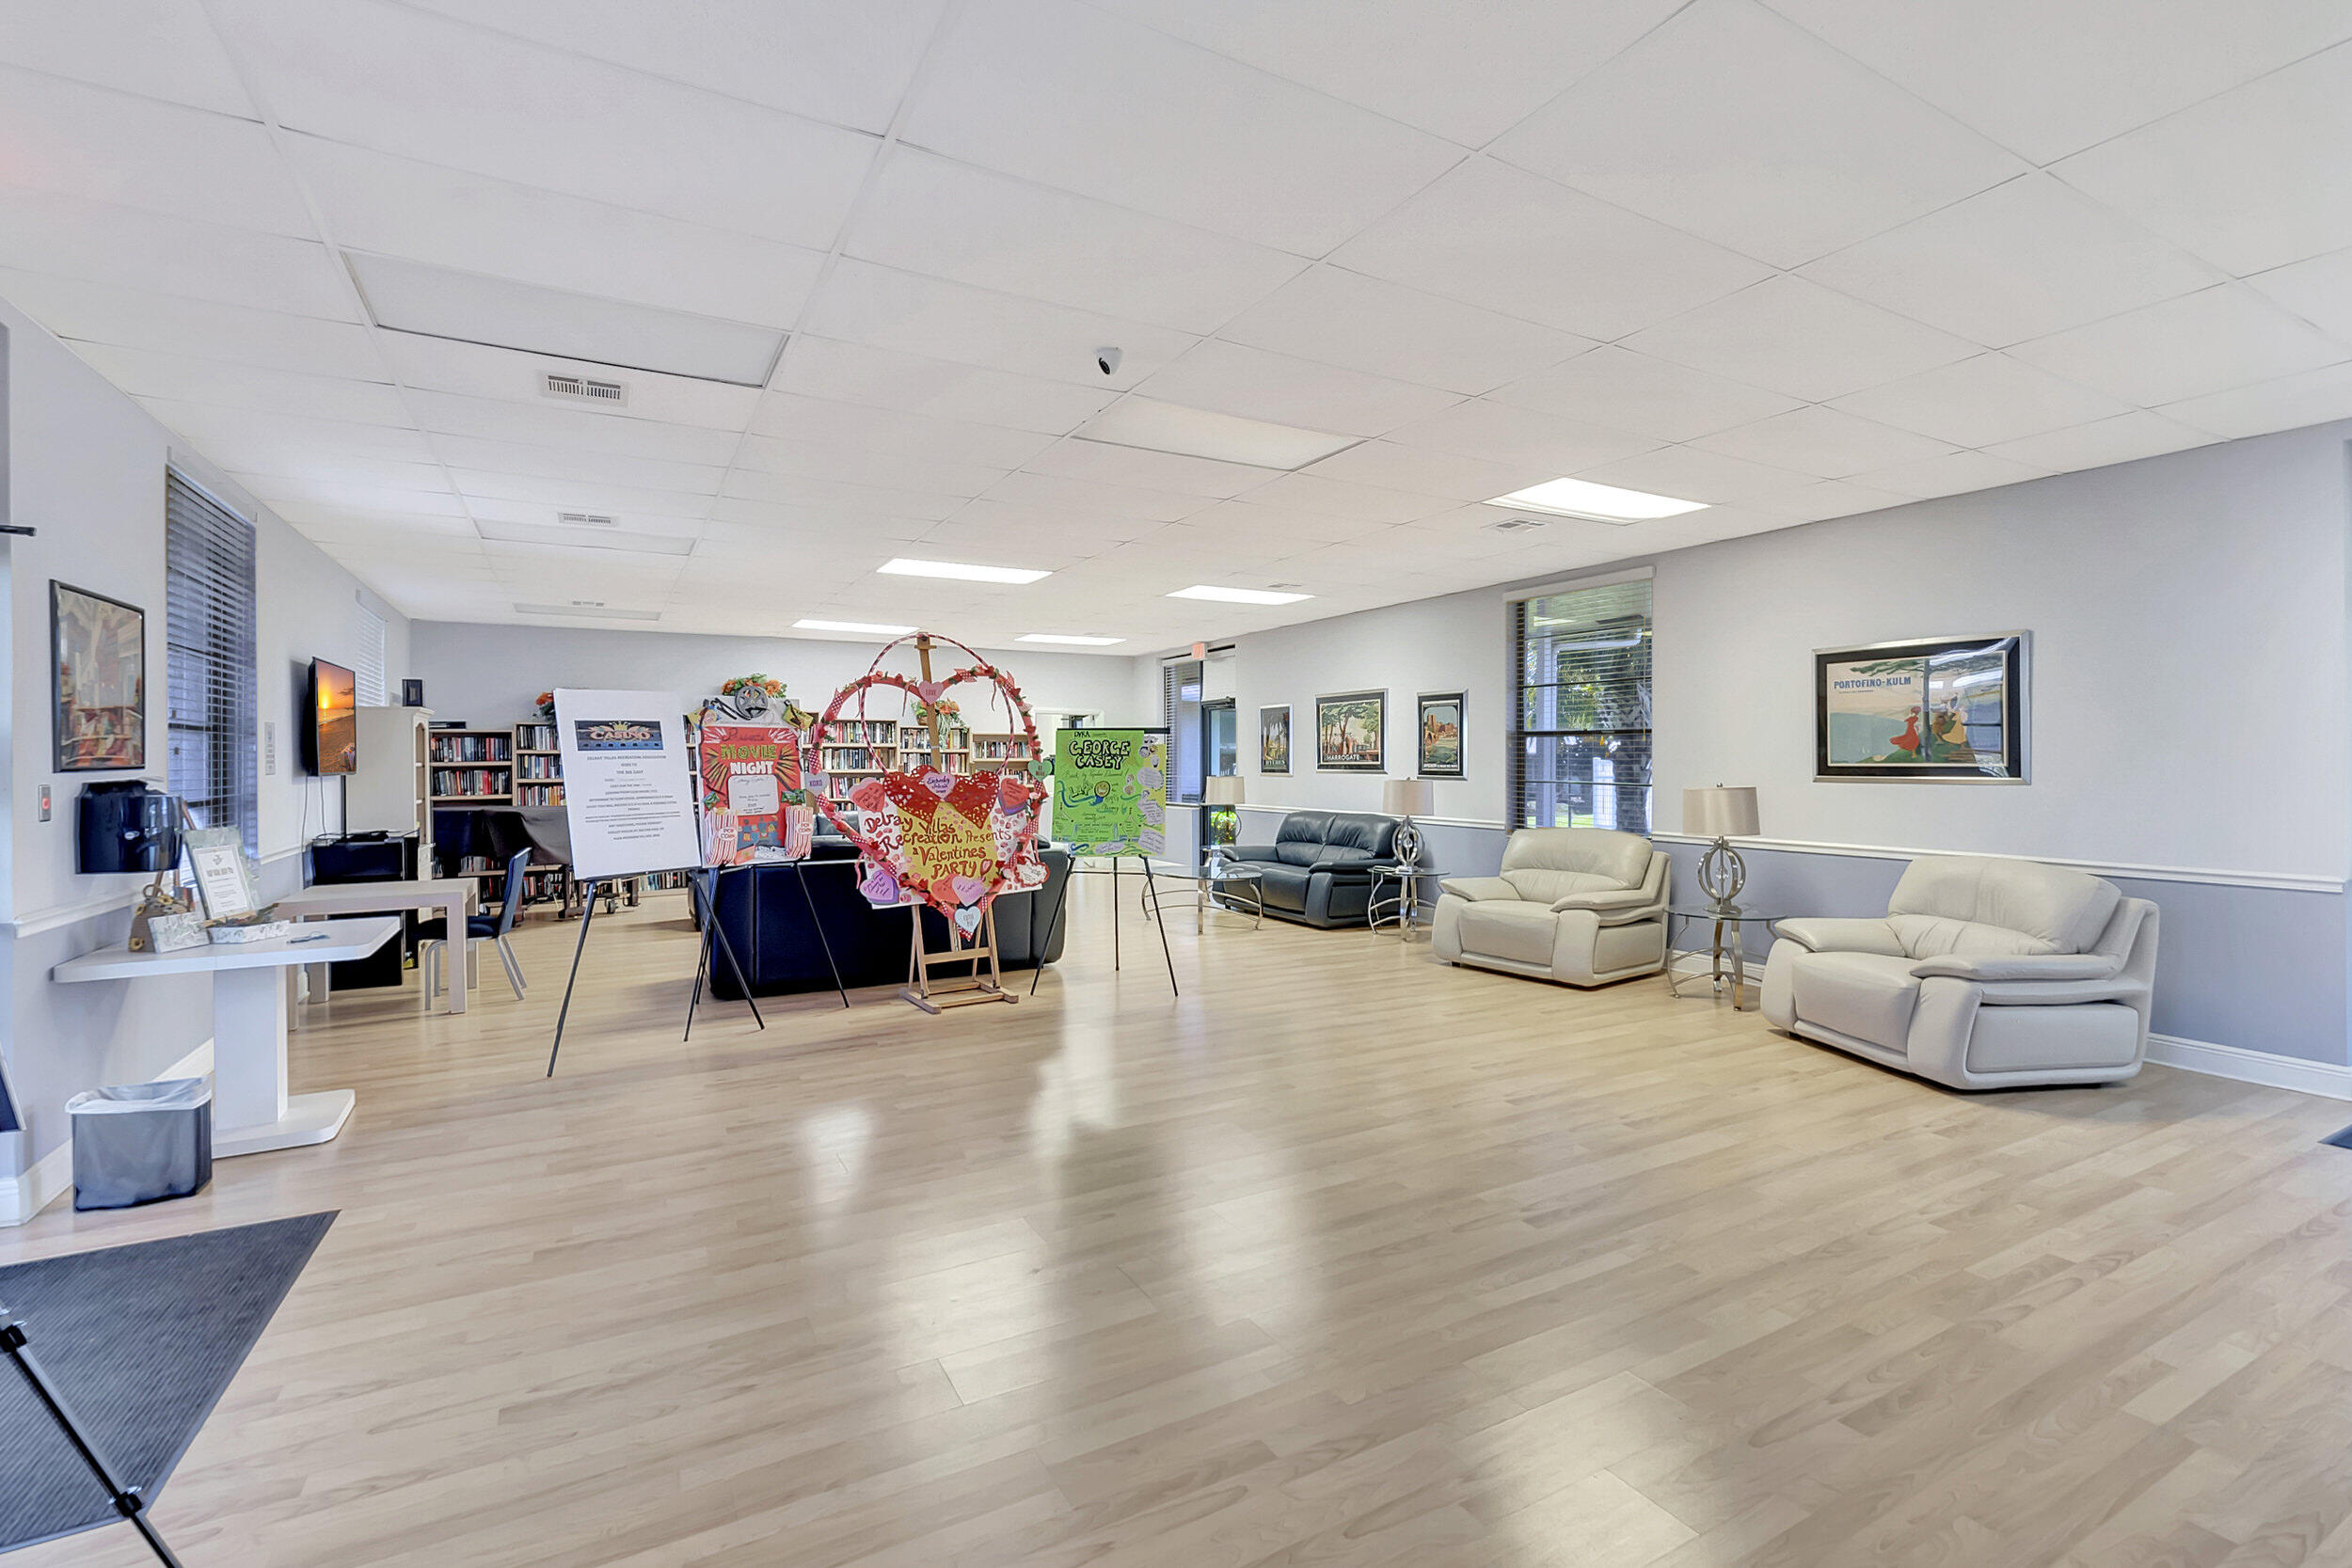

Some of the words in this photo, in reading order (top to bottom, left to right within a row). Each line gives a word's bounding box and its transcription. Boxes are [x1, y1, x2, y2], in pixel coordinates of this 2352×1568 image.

[1834, 676, 1912, 689] PORTOFINO-KULM
[590, 730, 651, 742] CASINO
[720, 744, 777, 760] MOVIE
[1069, 739, 1131, 756] GEORGE
[729, 760, 775, 775] NIGHT
[1075, 755, 1124, 770] CASEY
[864, 811, 914, 833] Delray
[918, 816, 957, 834] Villas
[965, 828, 1012, 845] Presents
[912, 847, 919, 855] a
[918, 845, 987, 866] Valentines
[930, 860, 977, 880] PARTY
